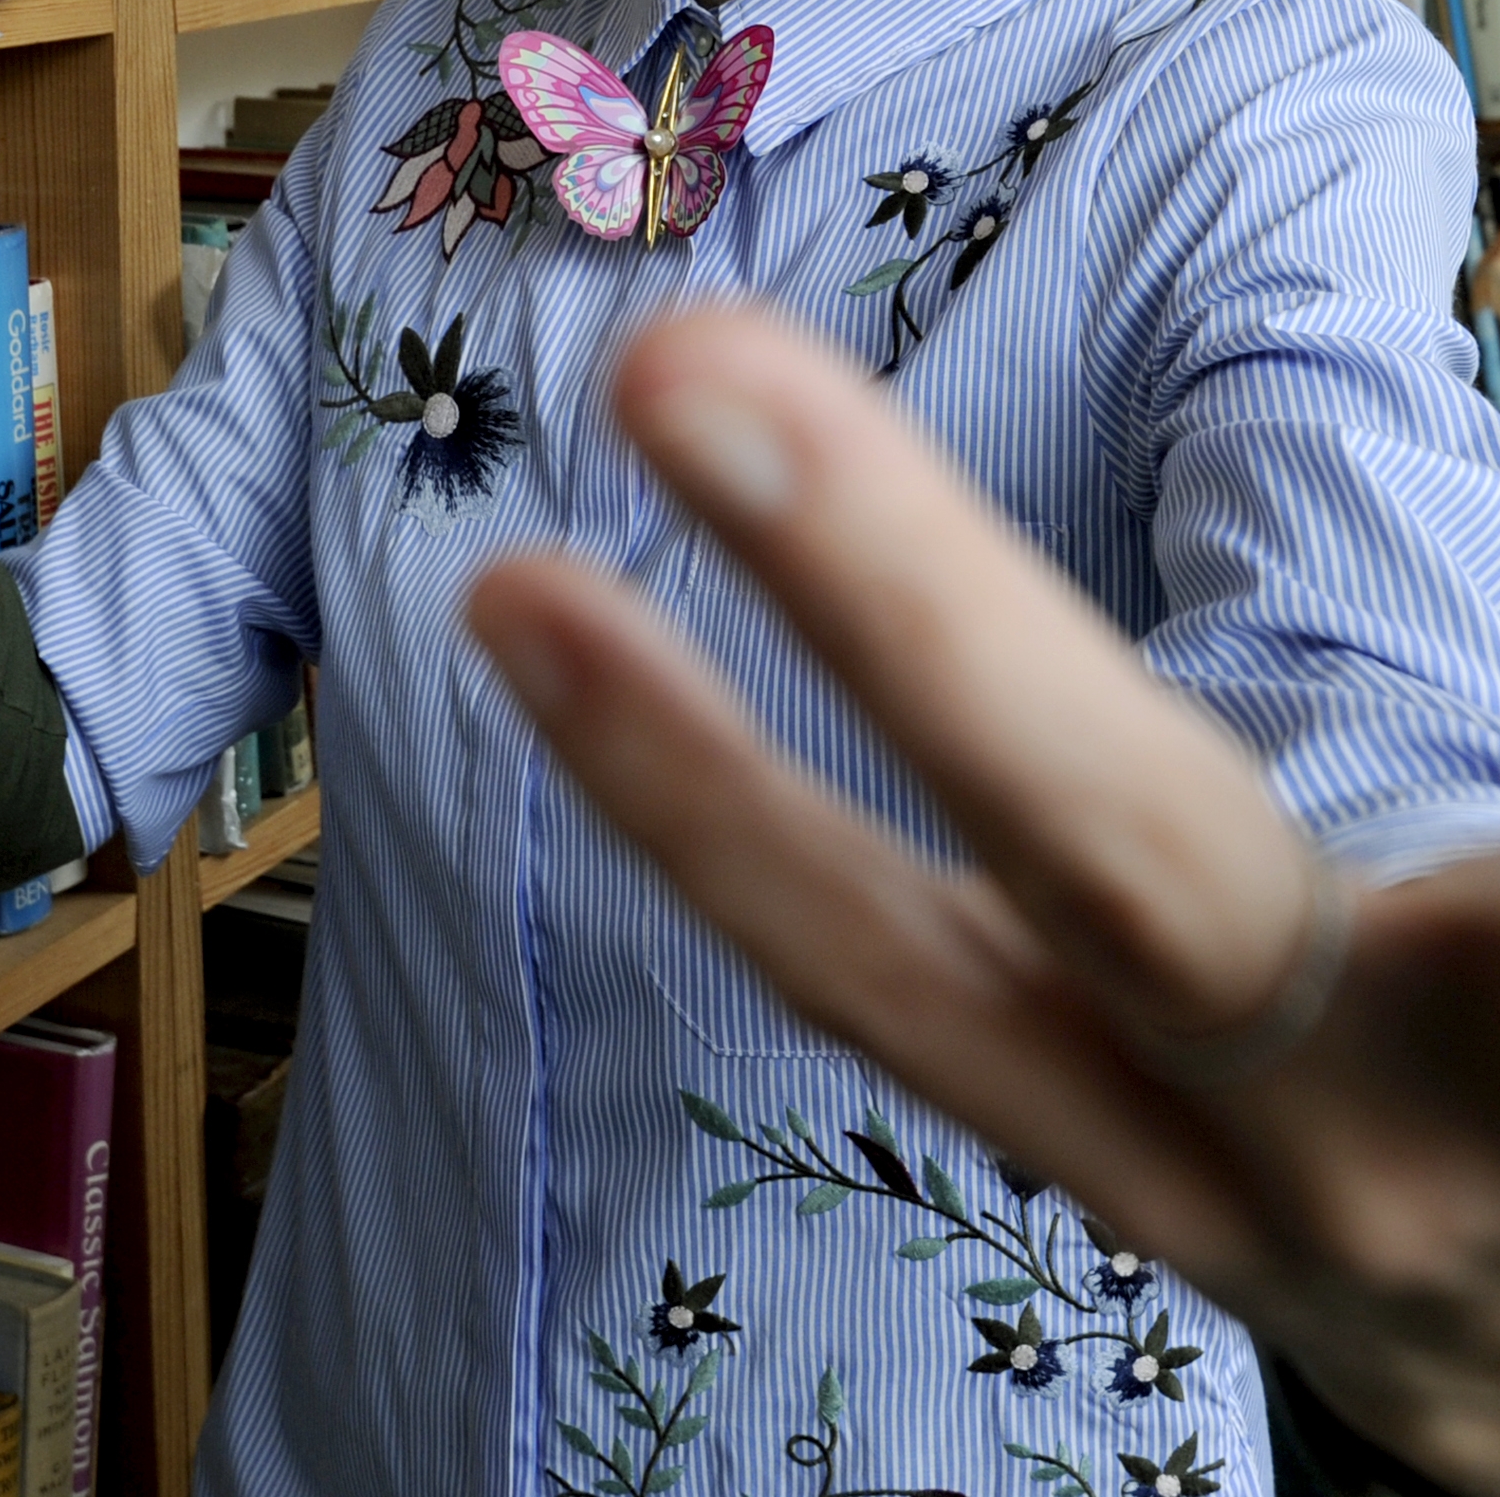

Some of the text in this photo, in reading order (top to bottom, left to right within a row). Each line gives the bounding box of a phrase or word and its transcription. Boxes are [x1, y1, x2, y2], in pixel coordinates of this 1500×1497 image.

[8, 308, 33, 444] Goddard
[39, 310, 50, 354] Rosie
[34, 397, 55, 450] THE
[72, 1139, 111, 1470] Classic Salmon
